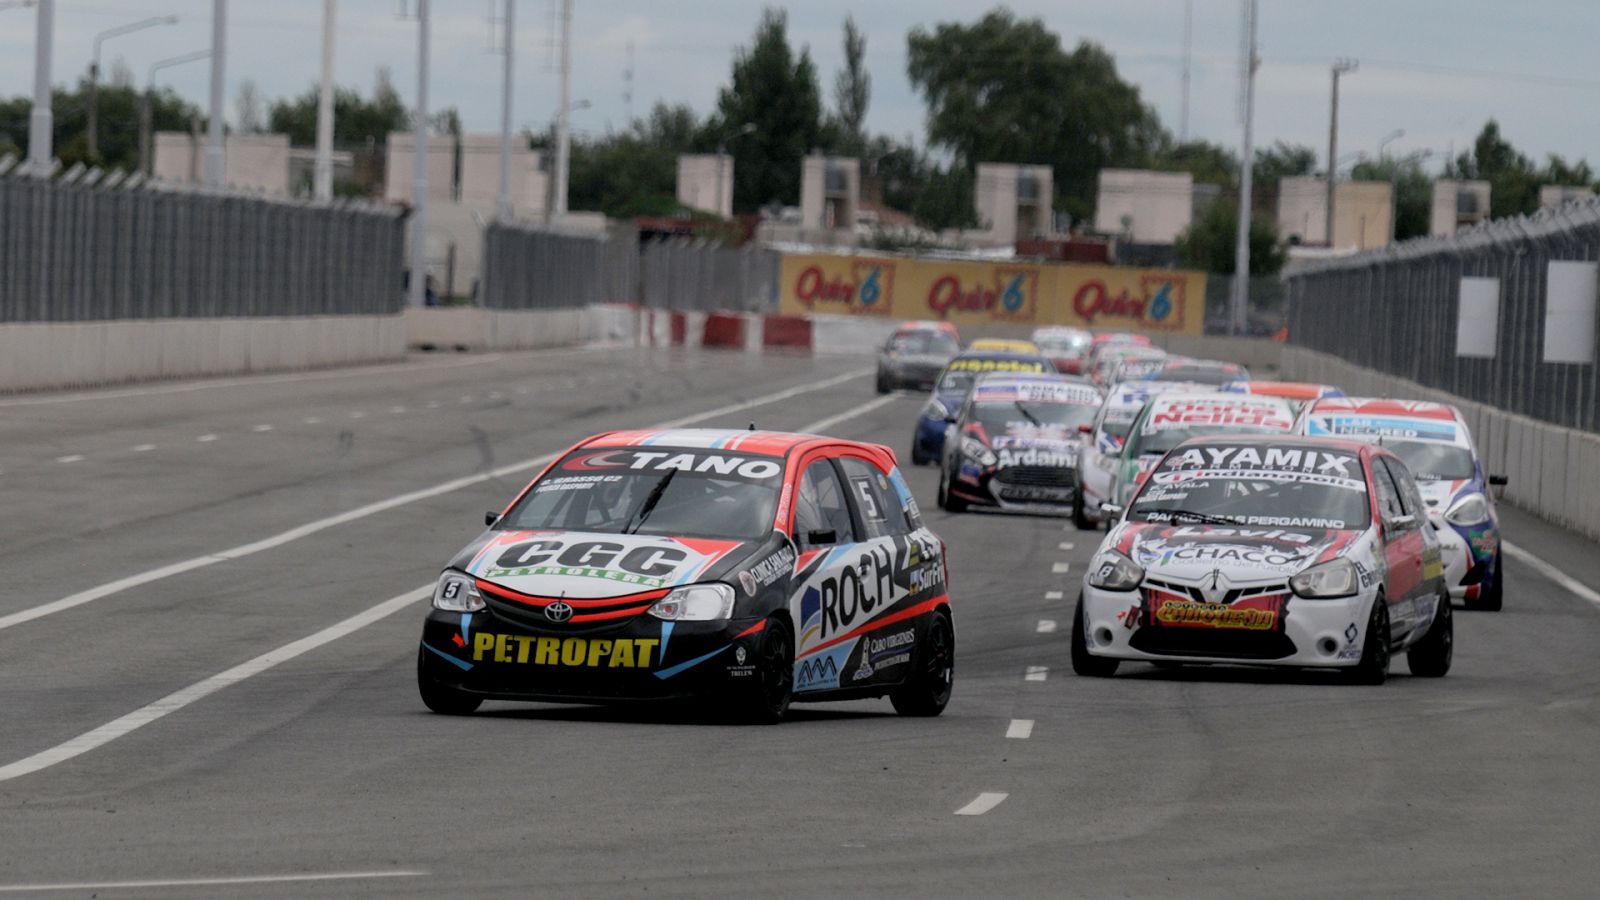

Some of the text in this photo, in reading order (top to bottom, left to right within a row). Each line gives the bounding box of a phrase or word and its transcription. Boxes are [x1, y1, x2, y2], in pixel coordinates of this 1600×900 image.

[861, 265, 881, 306] 6
[1003, 271, 1025, 311] 6
[1151, 280, 1172, 320] 6
[1181, 448, 1353, 473] AYAMIX
[858, 481, 877, 517] 5
[1247, 515, 1345, 529] PERGAMINO
[496, 540, 687, 577] CGC
[445, 582, 458, 598] 5
[486, 566, 661, 588] PETROLERA
[473, 632, 660, 668] PETROPAT
